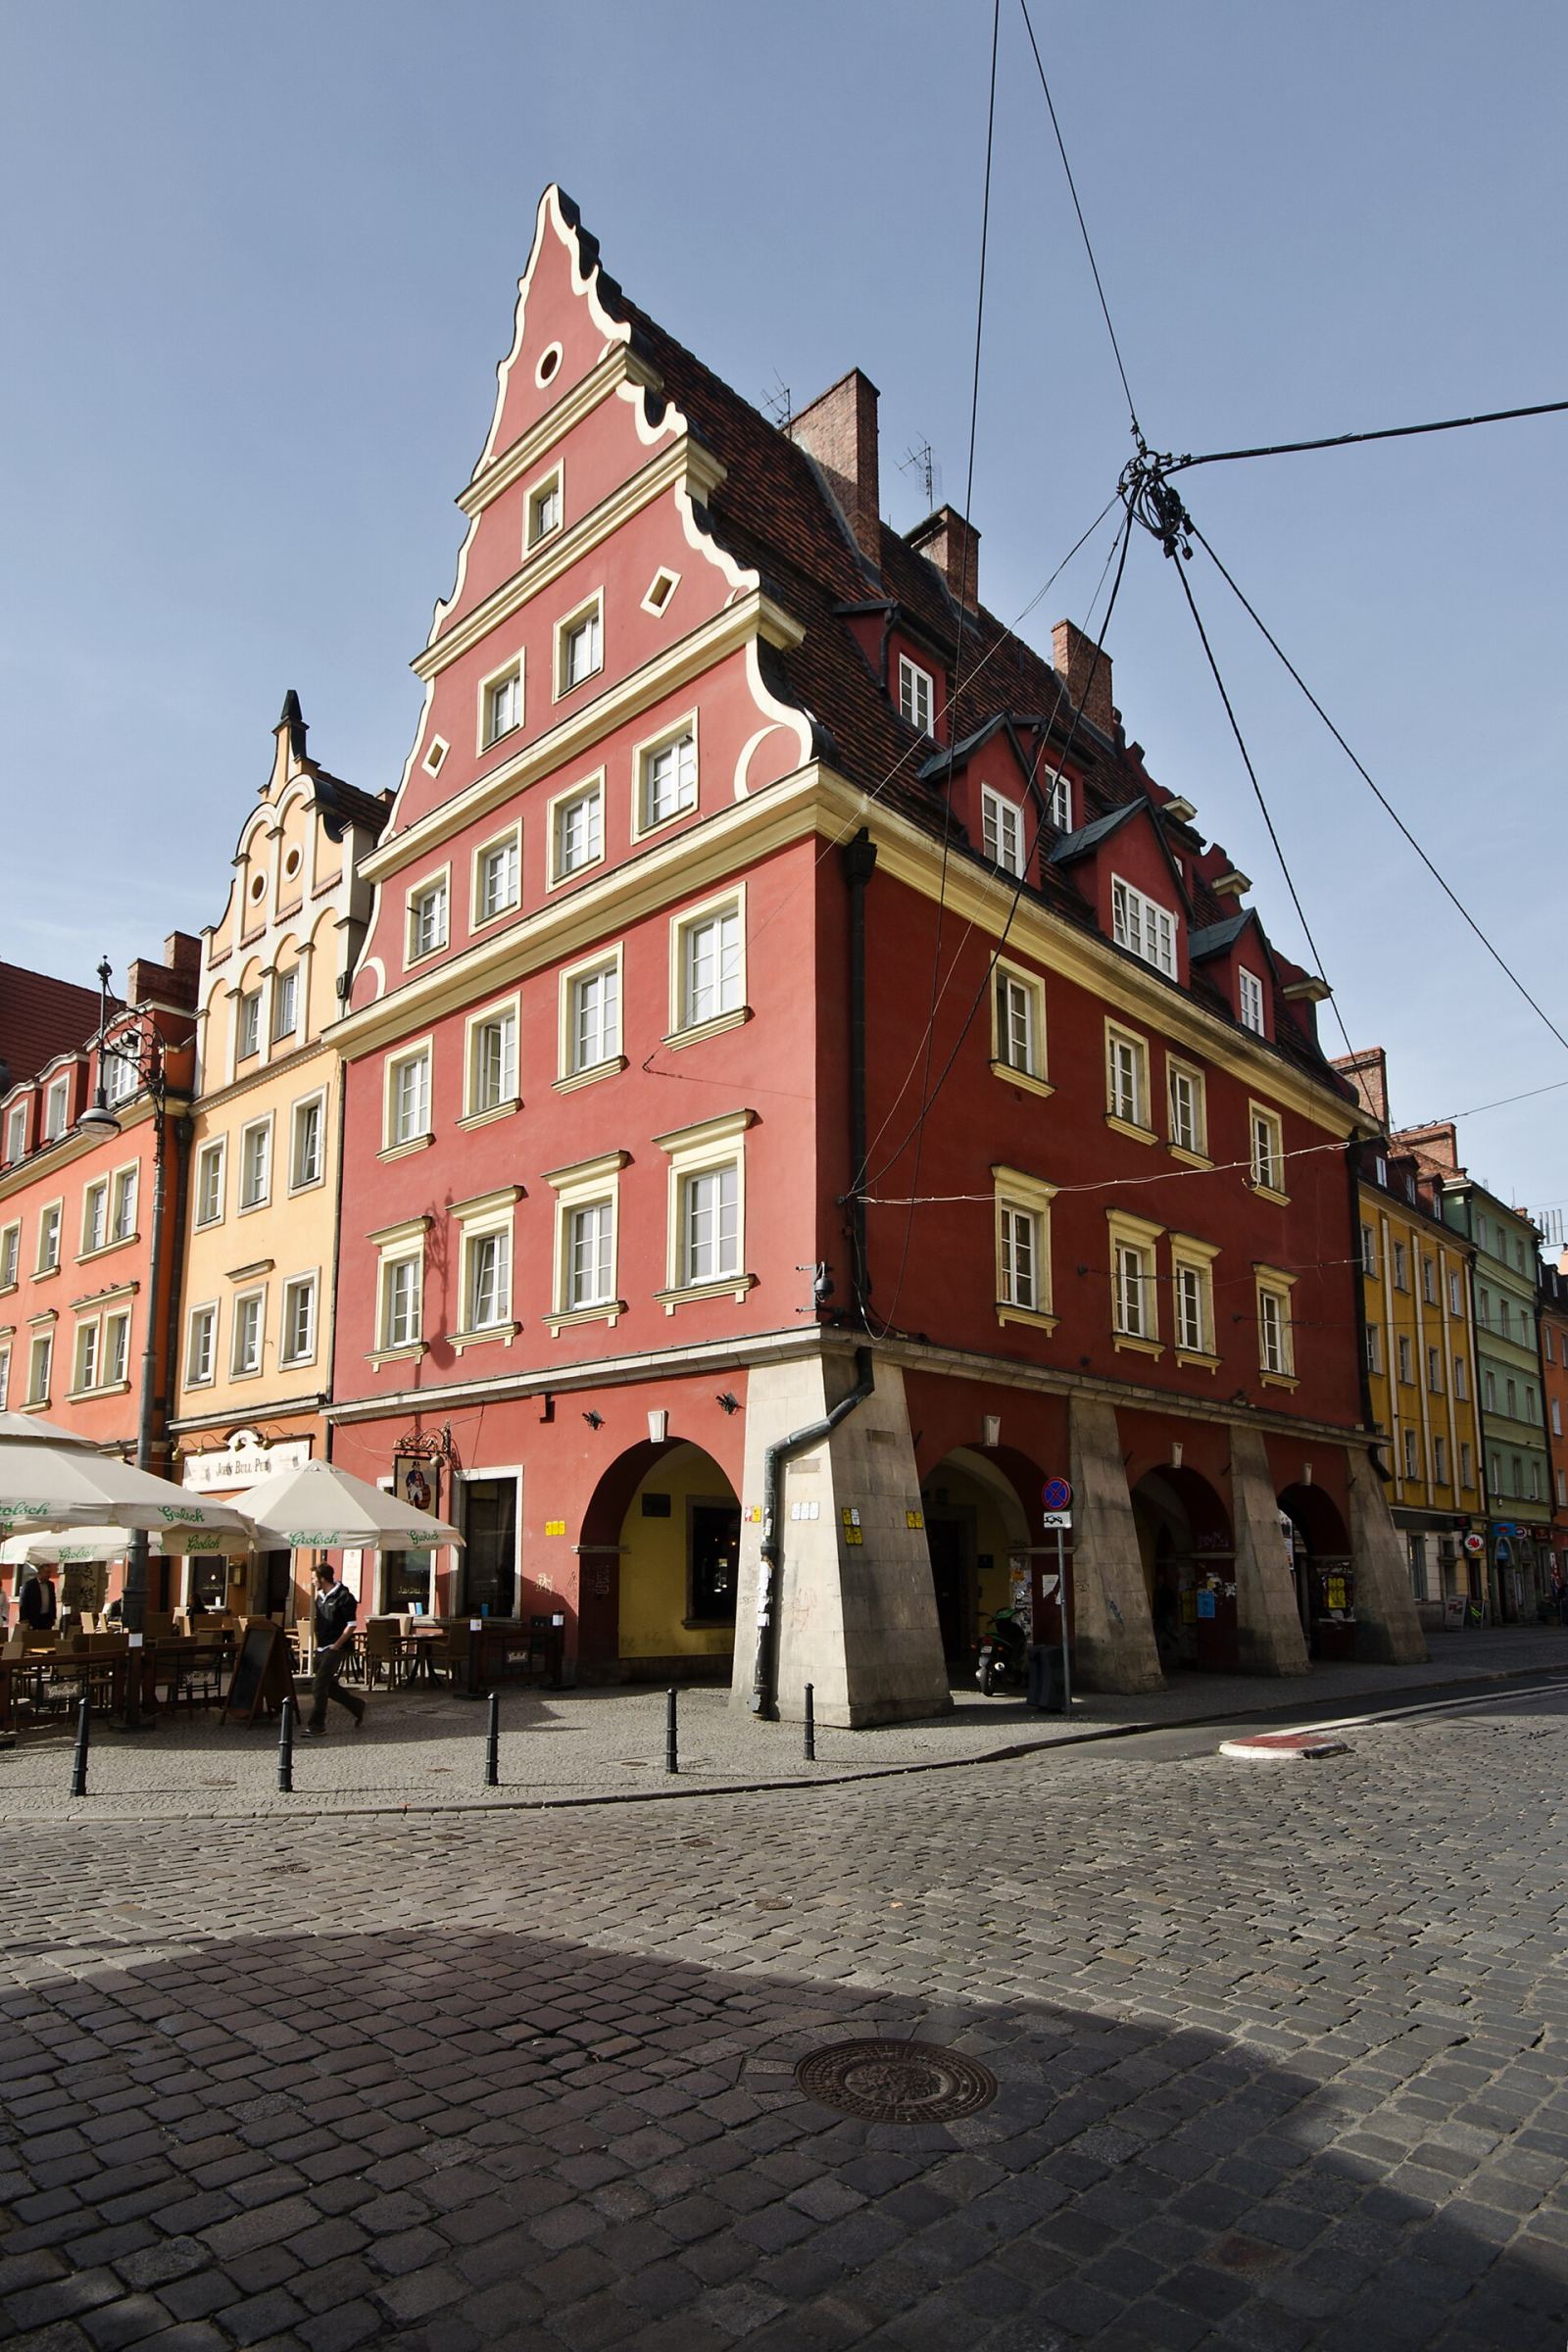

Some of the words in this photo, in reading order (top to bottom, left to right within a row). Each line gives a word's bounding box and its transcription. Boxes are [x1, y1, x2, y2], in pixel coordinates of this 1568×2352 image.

[0, 1501, 49, 1516] olsch
[157, 1505, 205, 1522] Grolsch
[288, 1531, 340, 1546] Grolsch
